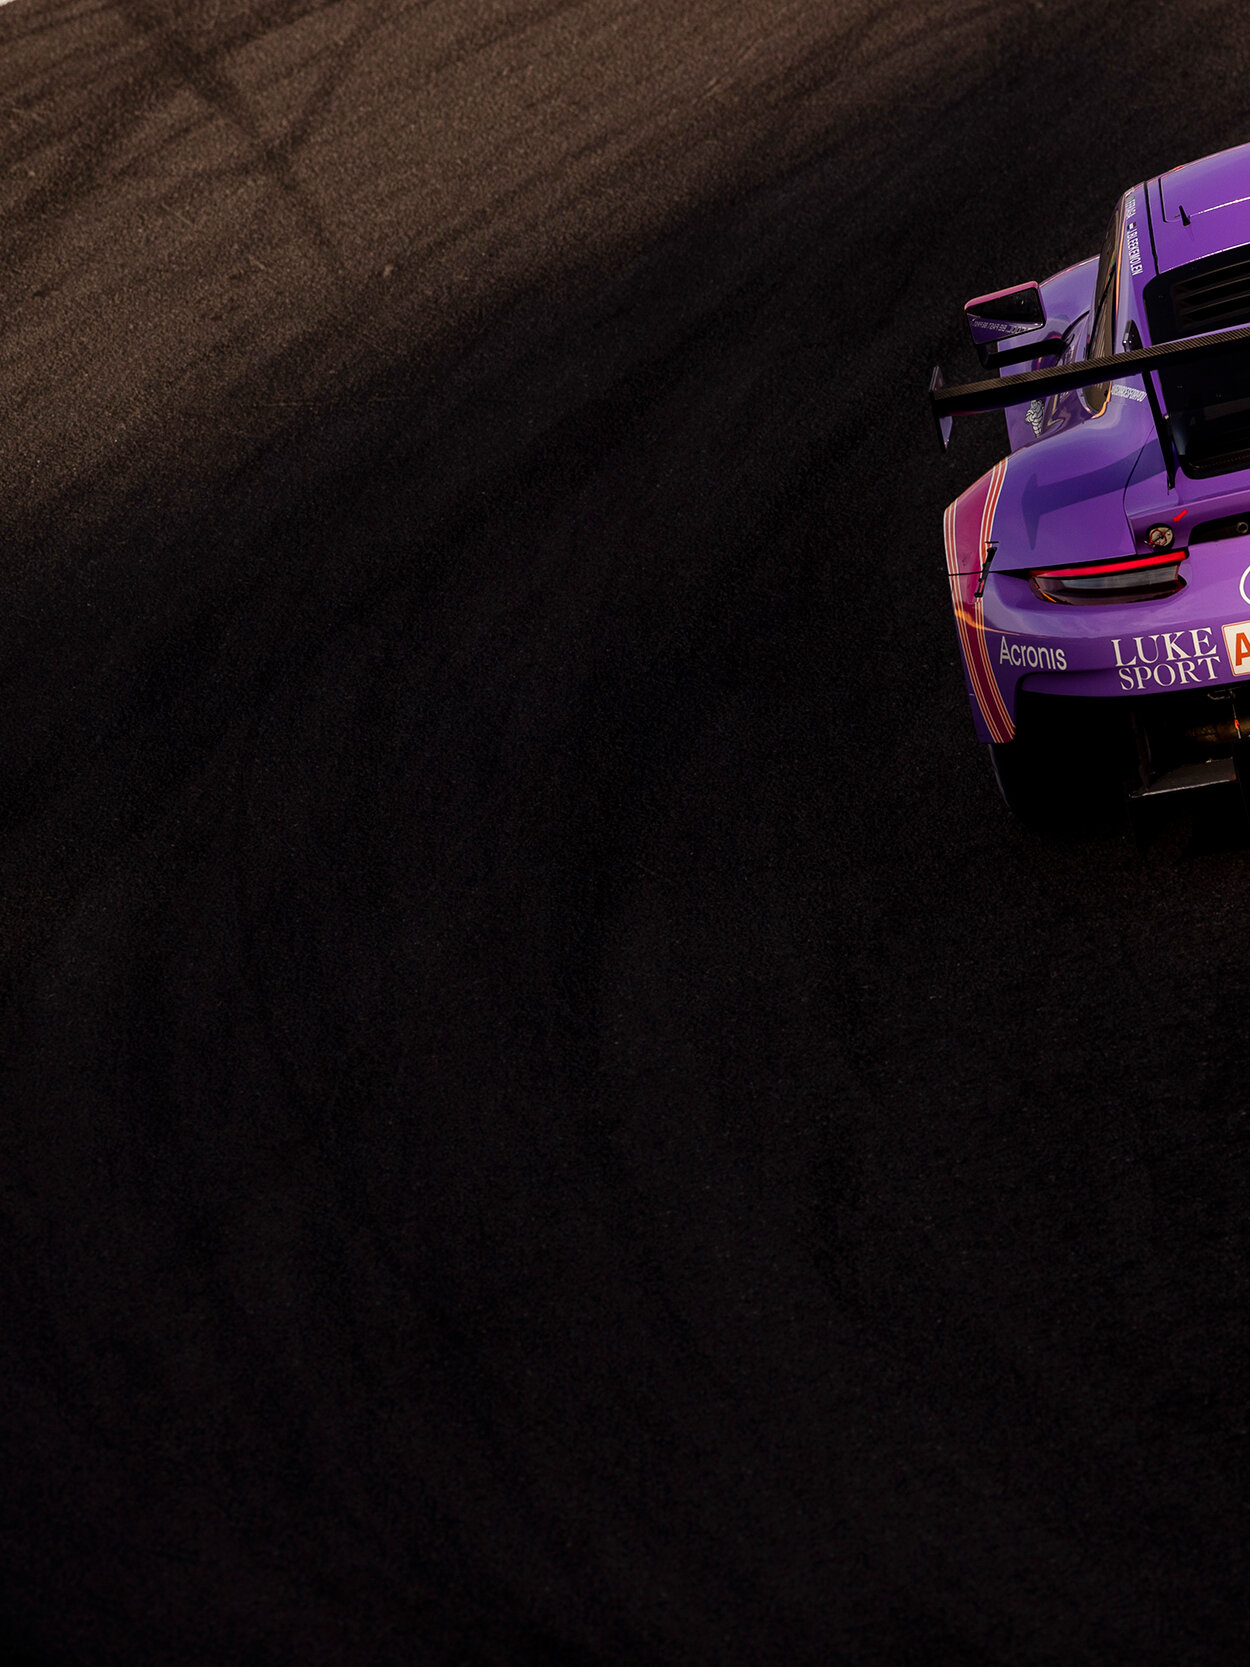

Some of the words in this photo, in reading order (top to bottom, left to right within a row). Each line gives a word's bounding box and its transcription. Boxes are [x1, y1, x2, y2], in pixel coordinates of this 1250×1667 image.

[1000, 635, 1067, 671] Acronis
[1111, 627, 1217, 667] LUKE
[1118, 655, 1221, 691] SPORT
